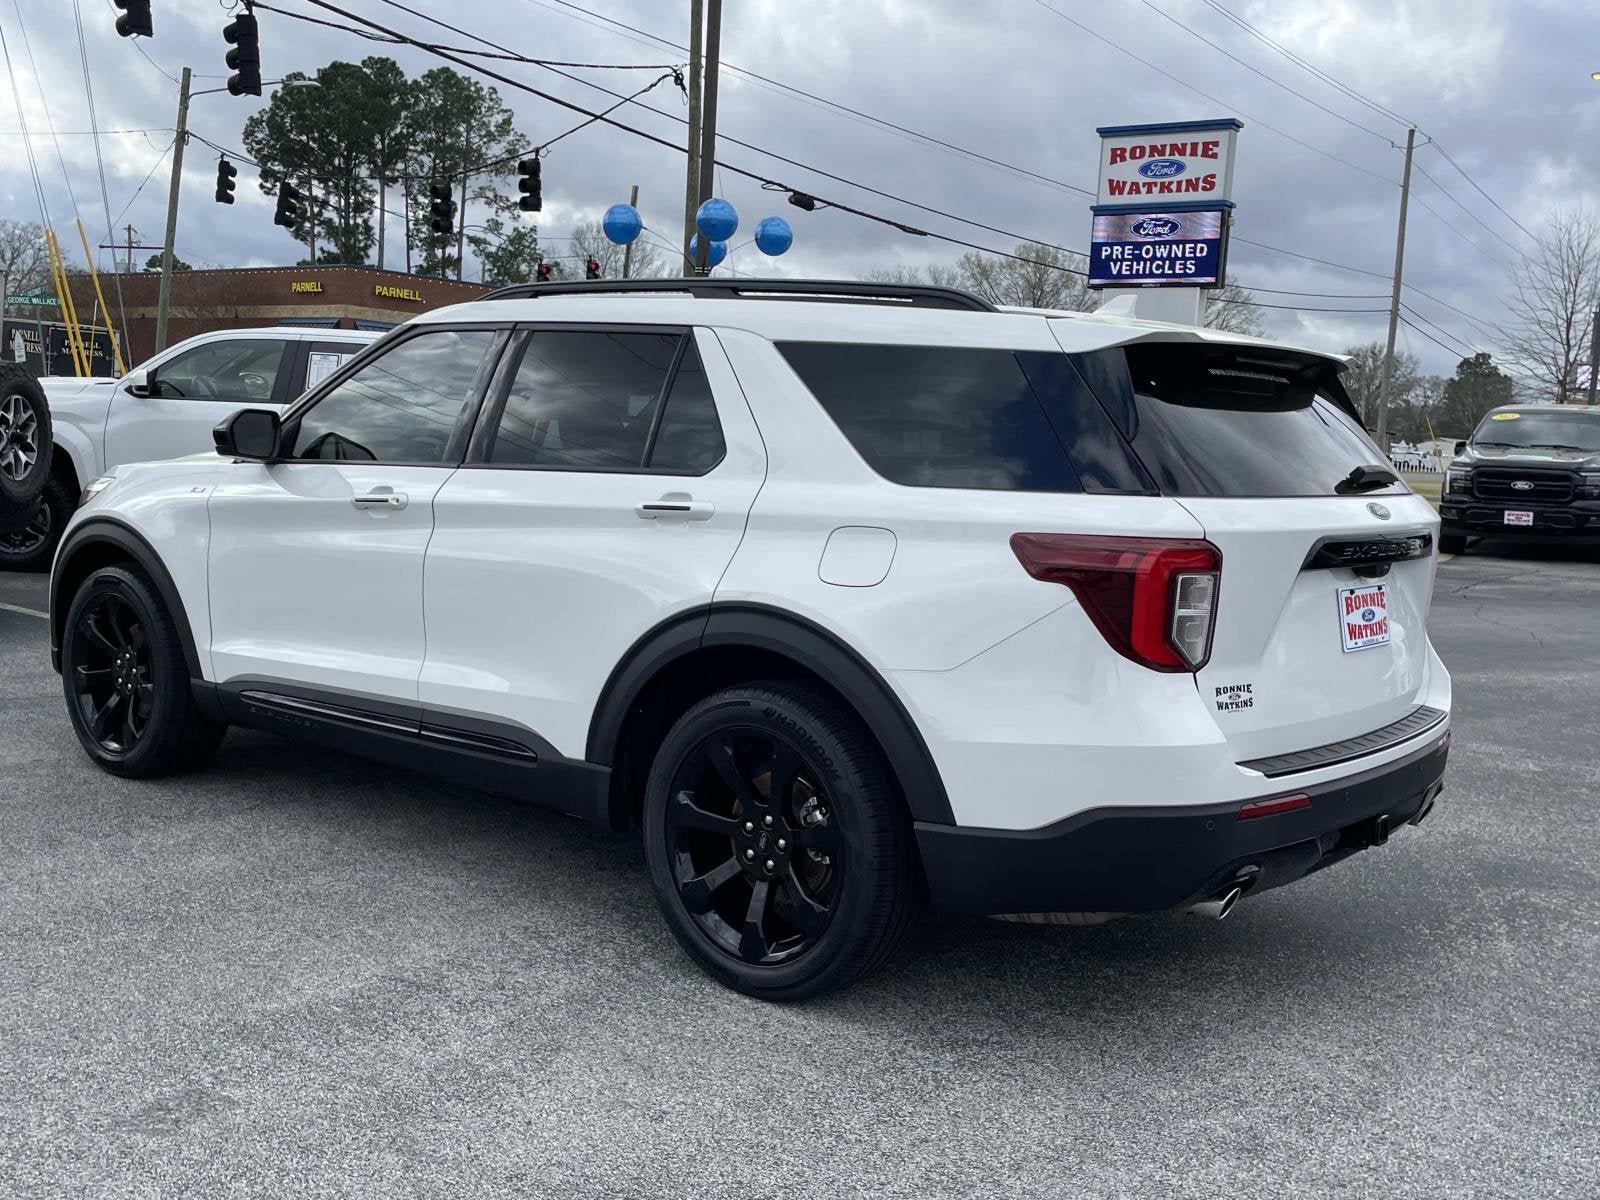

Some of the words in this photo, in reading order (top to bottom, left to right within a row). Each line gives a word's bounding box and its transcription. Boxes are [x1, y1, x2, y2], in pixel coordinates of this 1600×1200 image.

[1109, 140, 1220, 166] RONNIE
[1147, 162, 1177, 177] Ford
[1108, 173, 1217, 196] WATKINS
[1140, 220, 1171, 235] Ford
[1101, 243, 1208, 260] PRE-OWNED
[1110, 260, 1196, 275] VEHICLES
[292, 281, 323, 293] PARNELL
[375, 285, 422, 301] PARNELL
[31, 297, 58, 306] WALLACE
[1344, 591, 1386, 617] RONNIE
[1346, 615, 1388, 641] WATKINS
[1215, 683, 1253, 698] RONNIE
[1215, 697, 1254, 711] WATKINS
